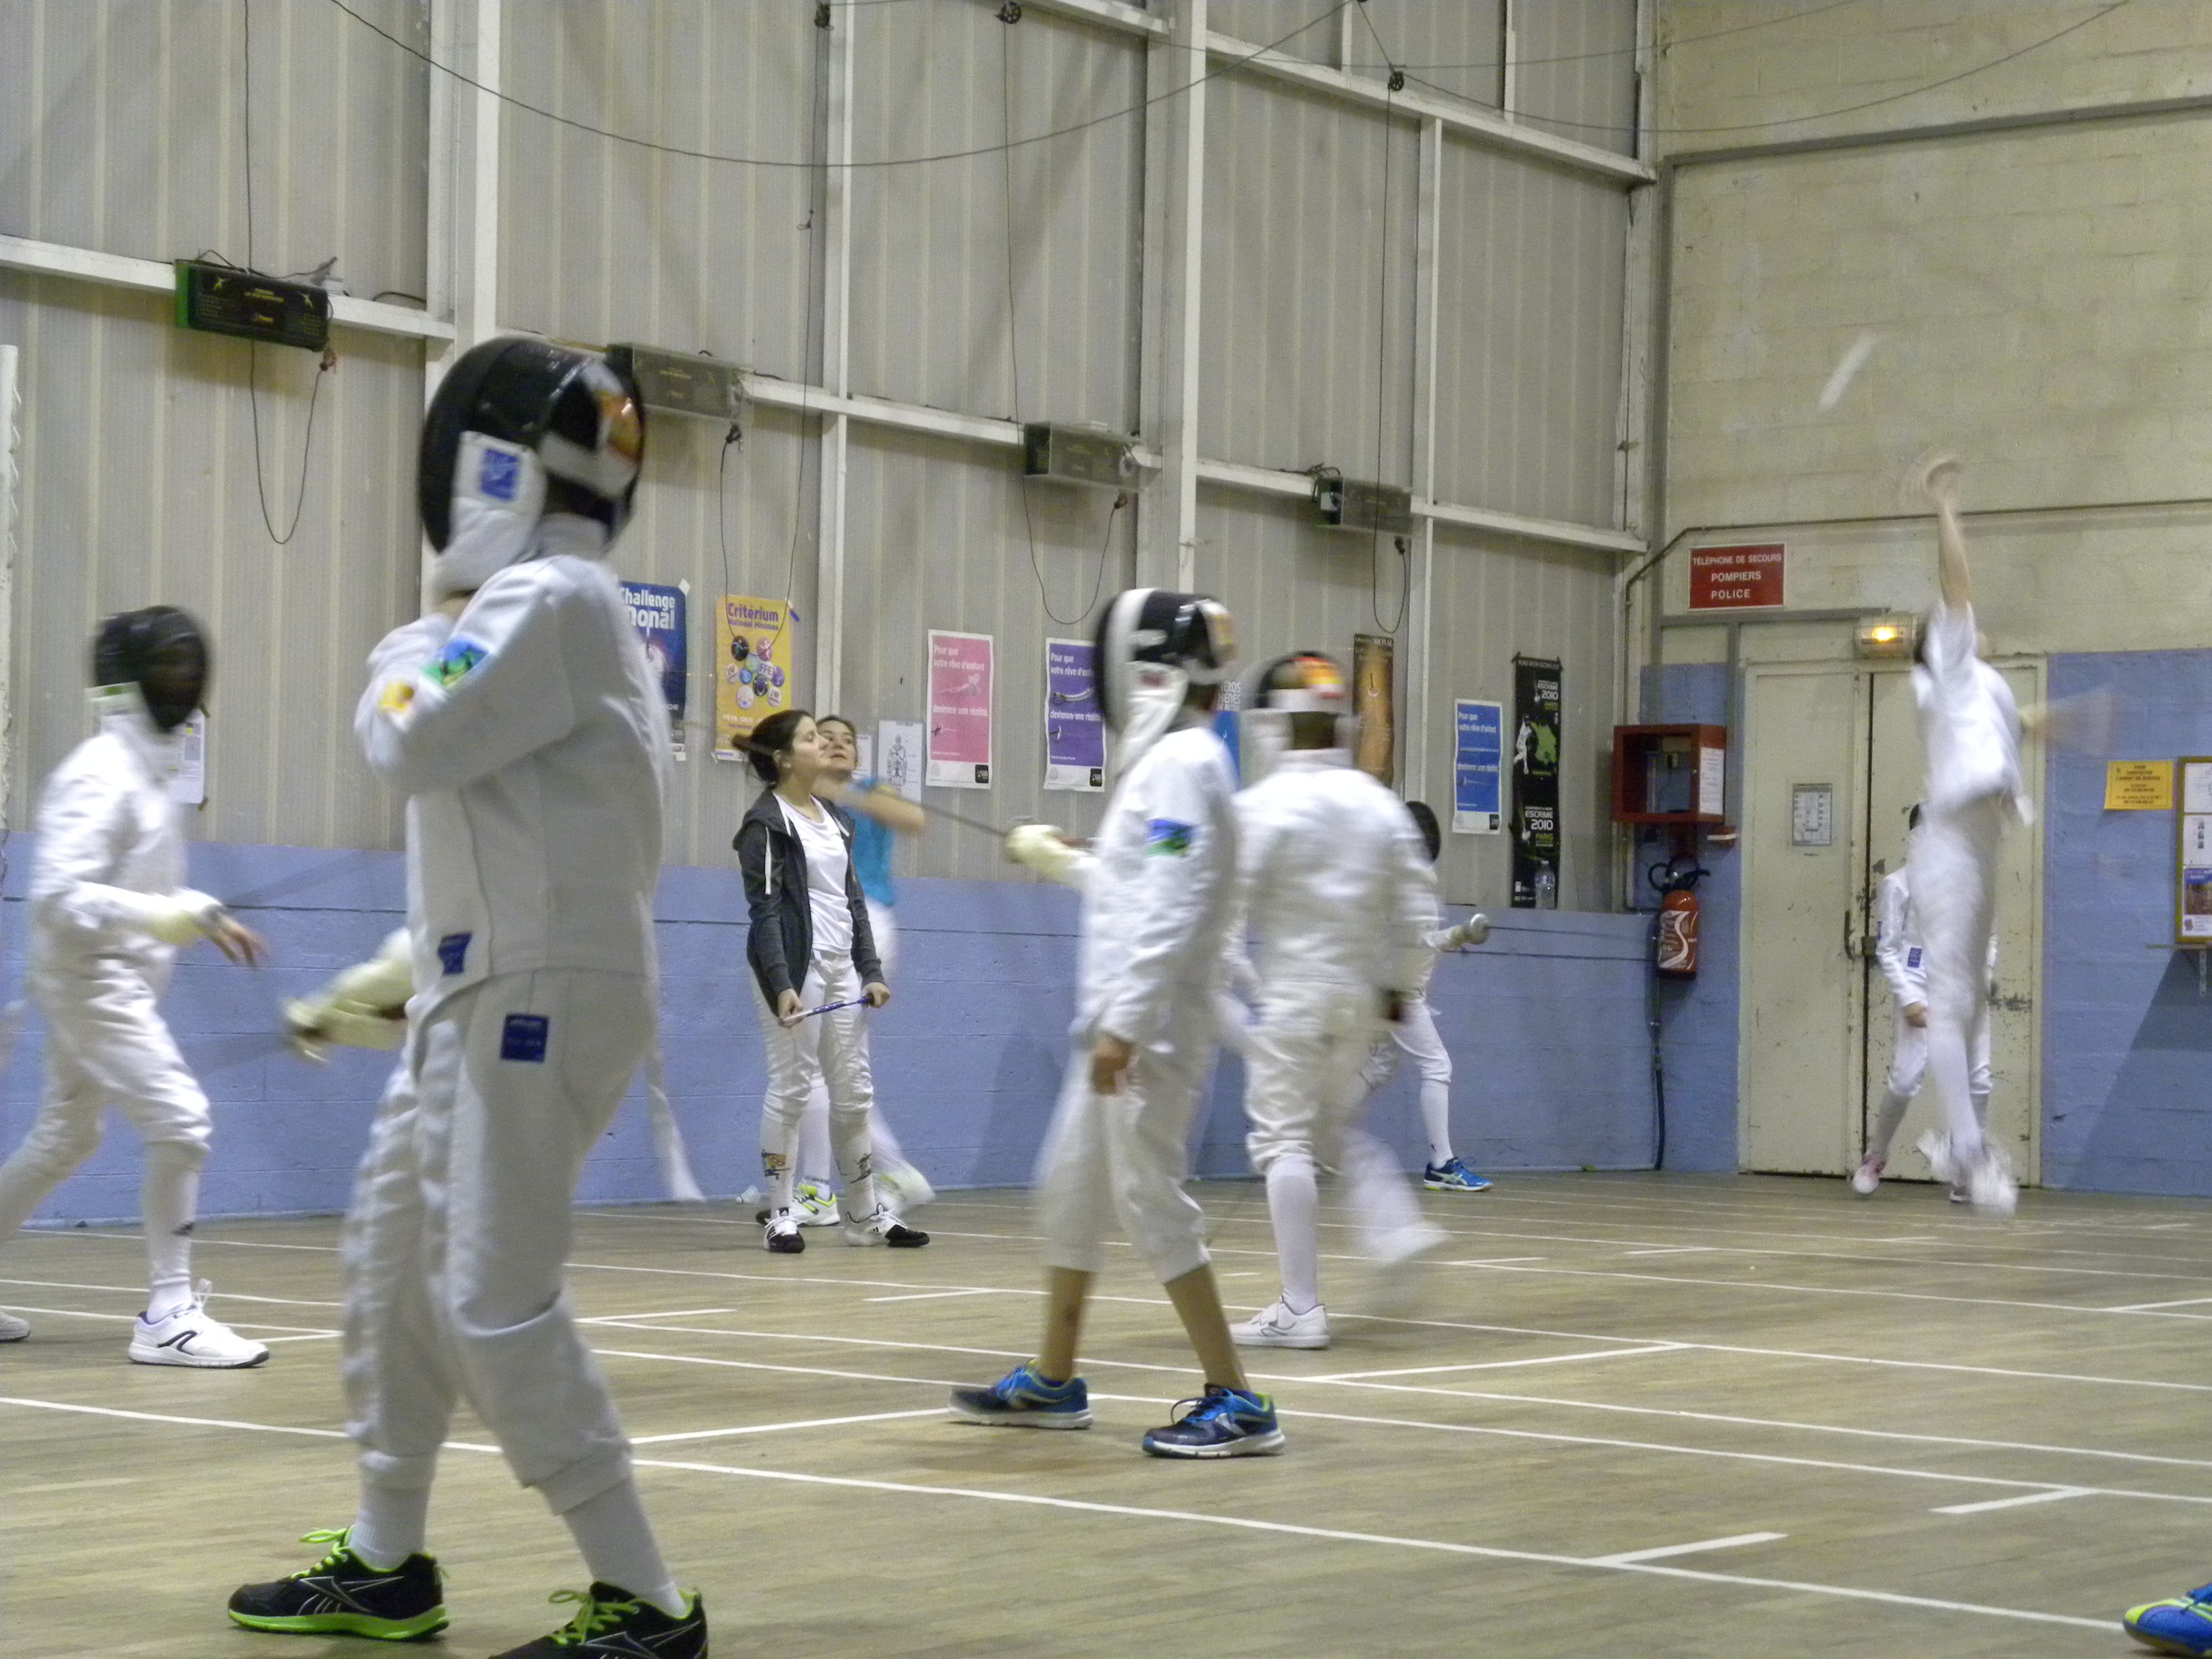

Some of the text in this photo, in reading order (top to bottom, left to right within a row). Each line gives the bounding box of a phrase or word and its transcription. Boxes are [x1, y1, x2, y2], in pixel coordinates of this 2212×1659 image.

[1736, 555, 1746, 564] DE
[1747, 553, 1782, 563] SECOURS
[1711, 571, 1762, 582] POMPIERS
[1710, 589, 1751, 600] POLICE
[728, 602, 779, 622] Critérium
[1541, 690, 1559, 701] 2010
[1525, 810, 1553, 819] ESCRIME
[1531, 818, 1554, 831] 2010
